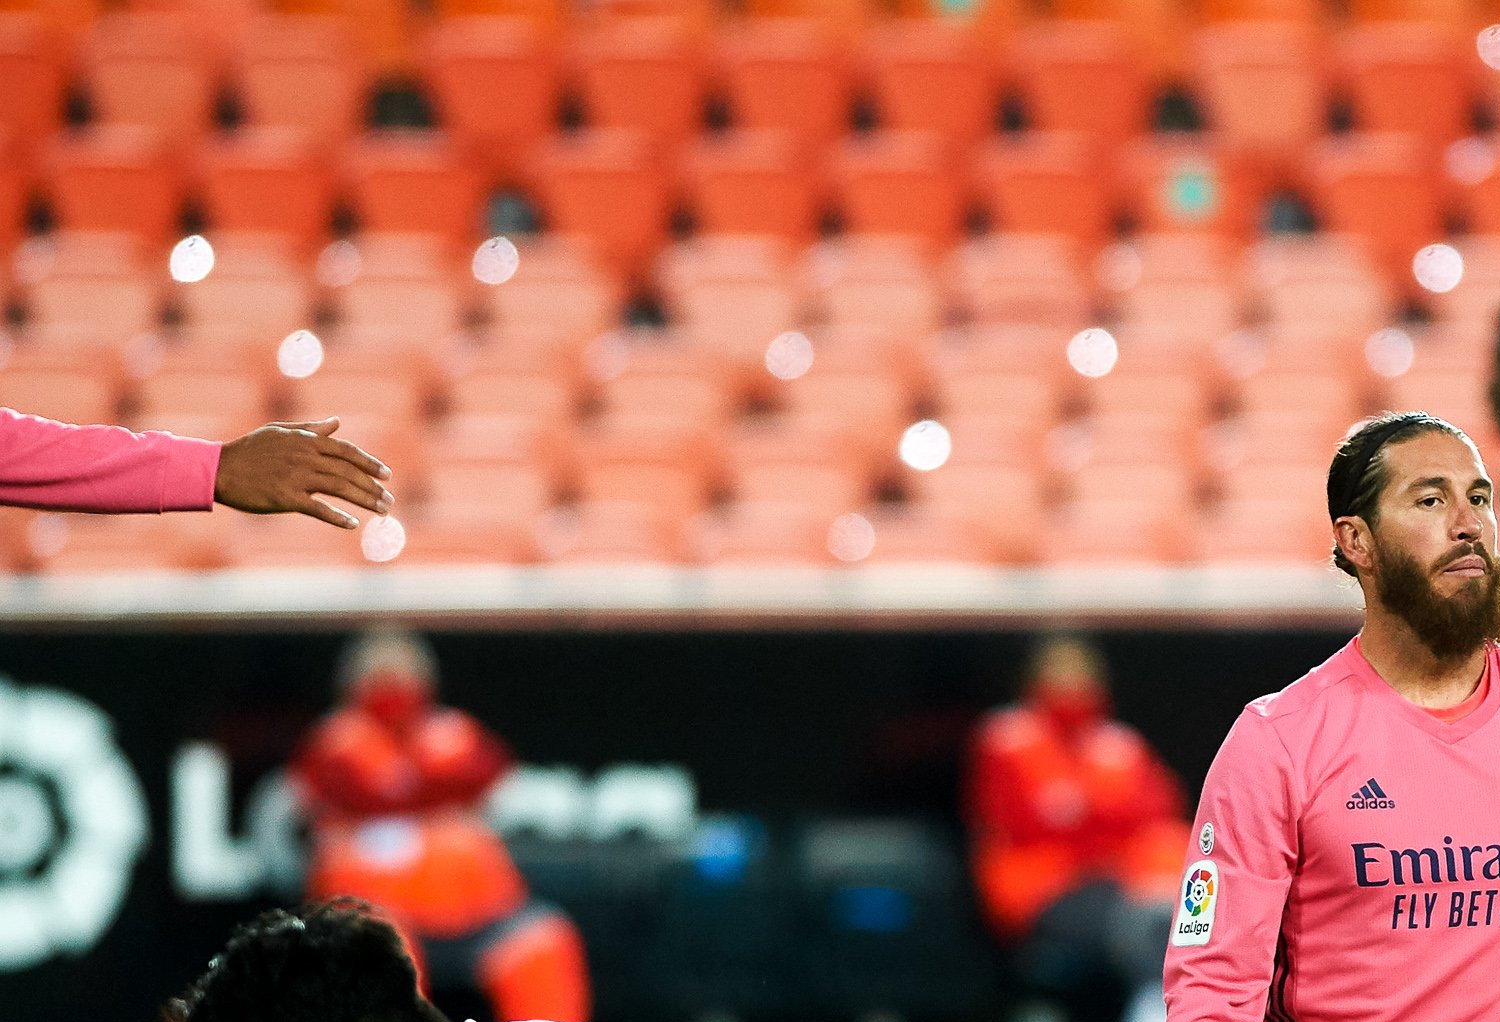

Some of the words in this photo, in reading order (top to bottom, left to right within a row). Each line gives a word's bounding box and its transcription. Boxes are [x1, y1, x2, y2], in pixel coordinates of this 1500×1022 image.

[1345, 797, 1396, 810] adidas
[1391, 892, 1438, 930] FLY
[1178, 920, 1210, 935] LaLiga
